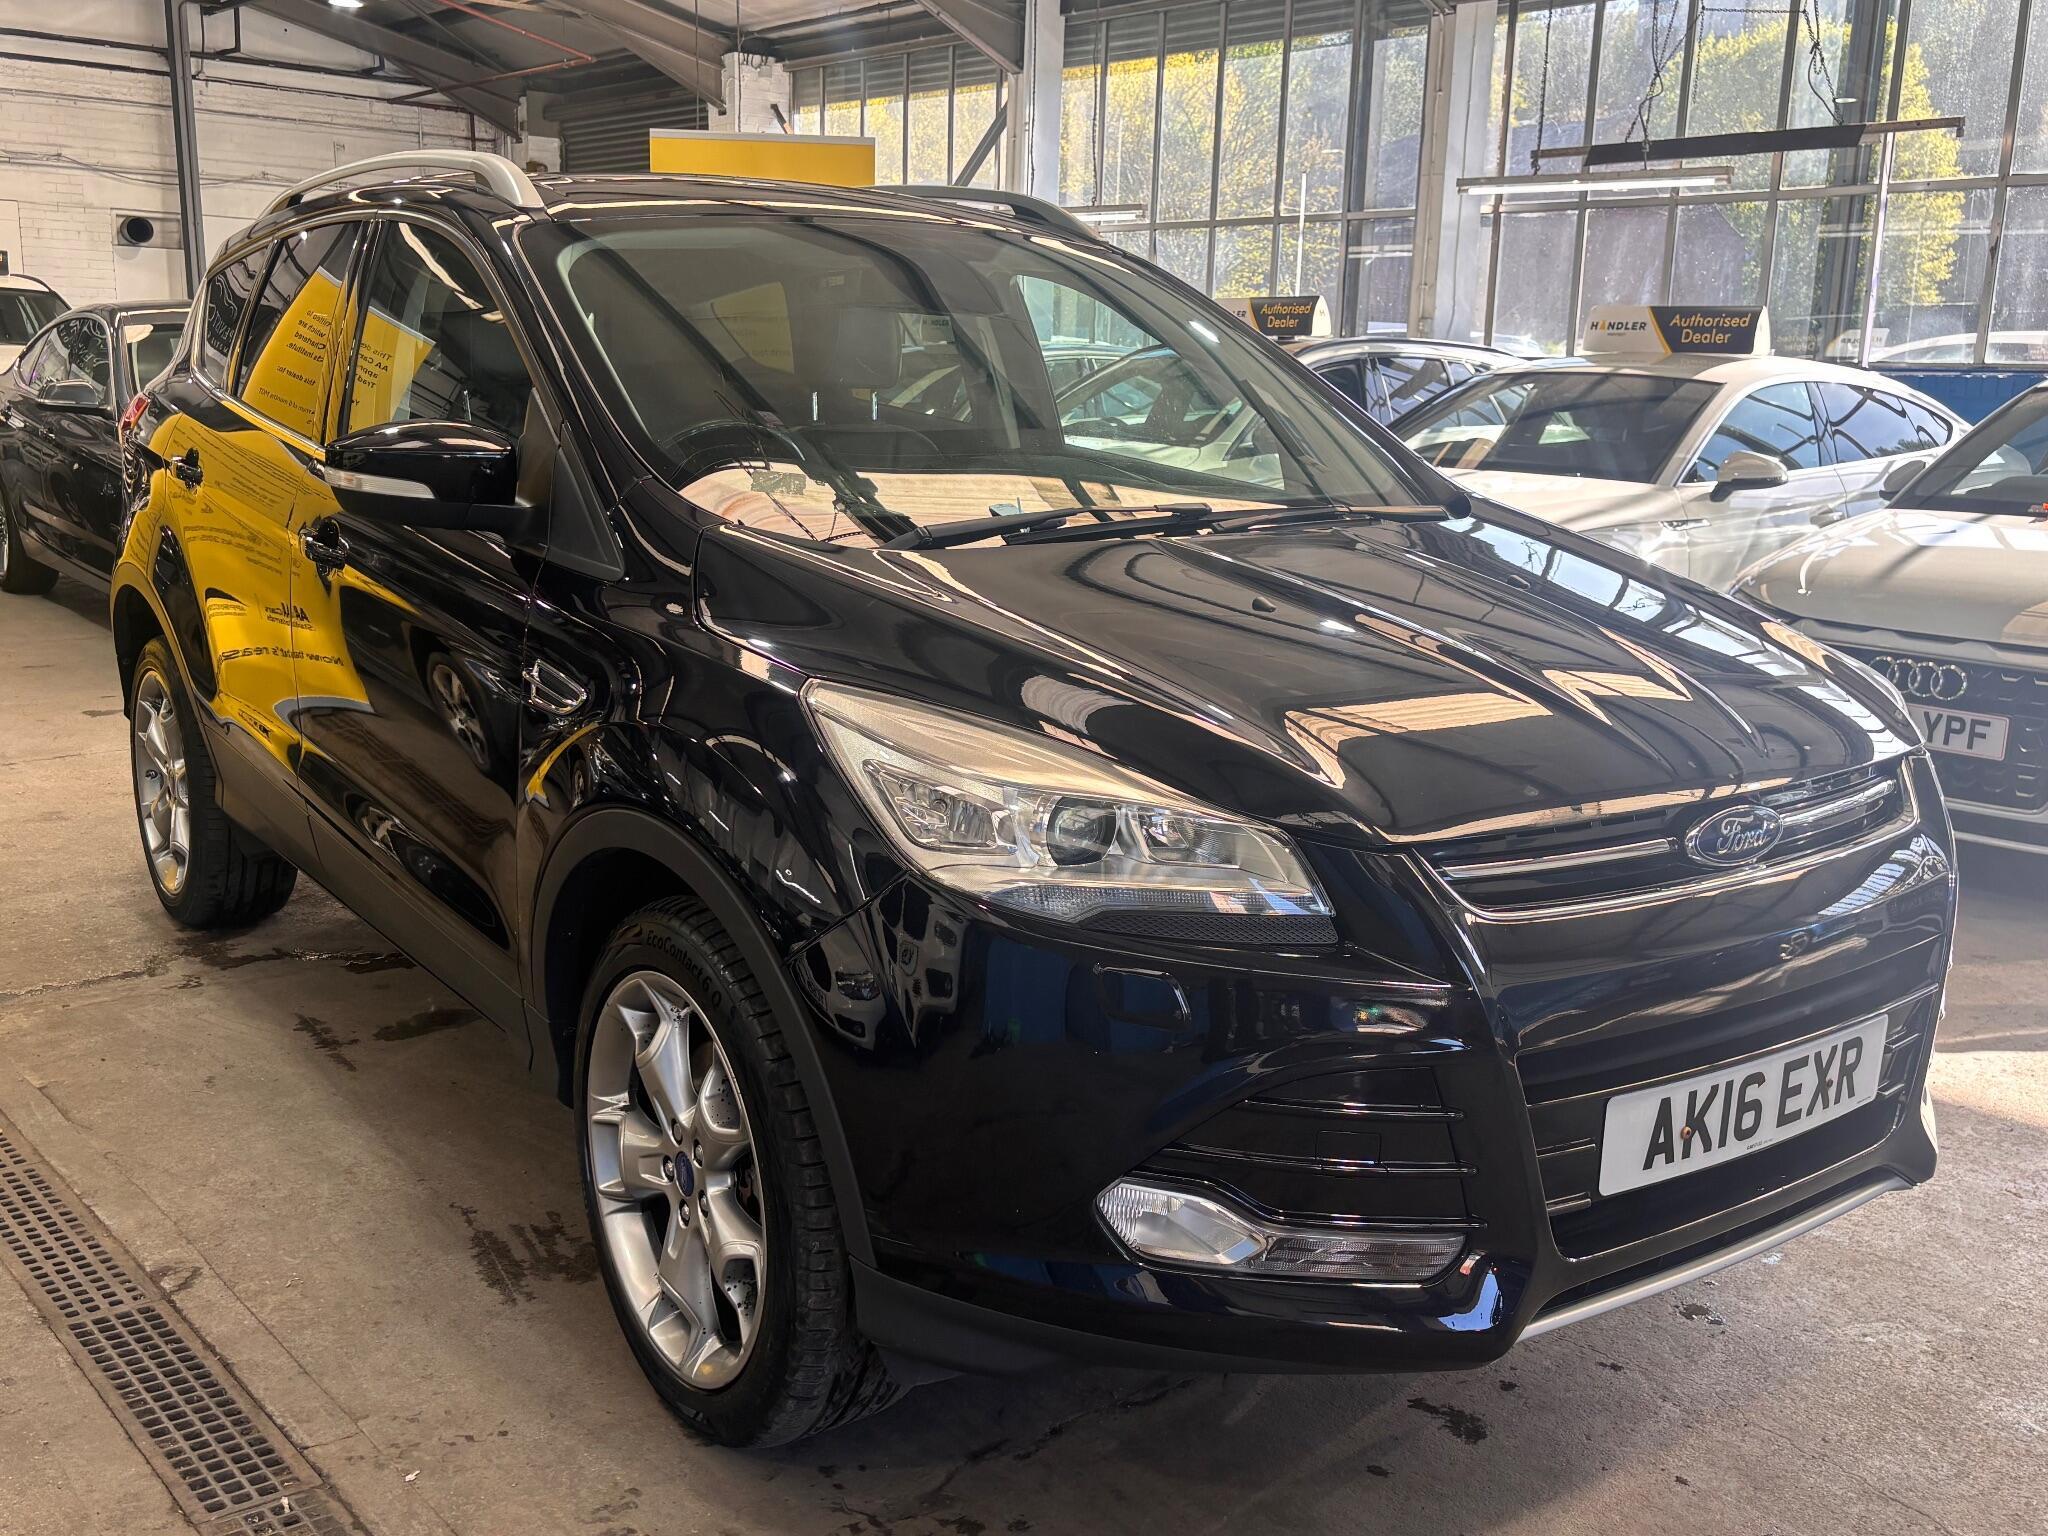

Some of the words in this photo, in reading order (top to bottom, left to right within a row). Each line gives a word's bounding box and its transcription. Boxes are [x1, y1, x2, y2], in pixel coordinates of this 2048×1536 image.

[1260, 302, 1312, 315] Authorised
[1267, 316, 1300, 328] Dealer
[1669, 313, 1752, 328] Authorised
[1681, 329, 1732, 344] Dealer
[1923, 711, 1991, 750] YPF
[1716, 814, 1771, 856] Ford
[646, 929, 704, 979] EcoContact
[702, 976, 713, 992] 6
[1642, 1071, 1767, 1171] AK16
[1776, 1036, 1864, 1129] EXR
